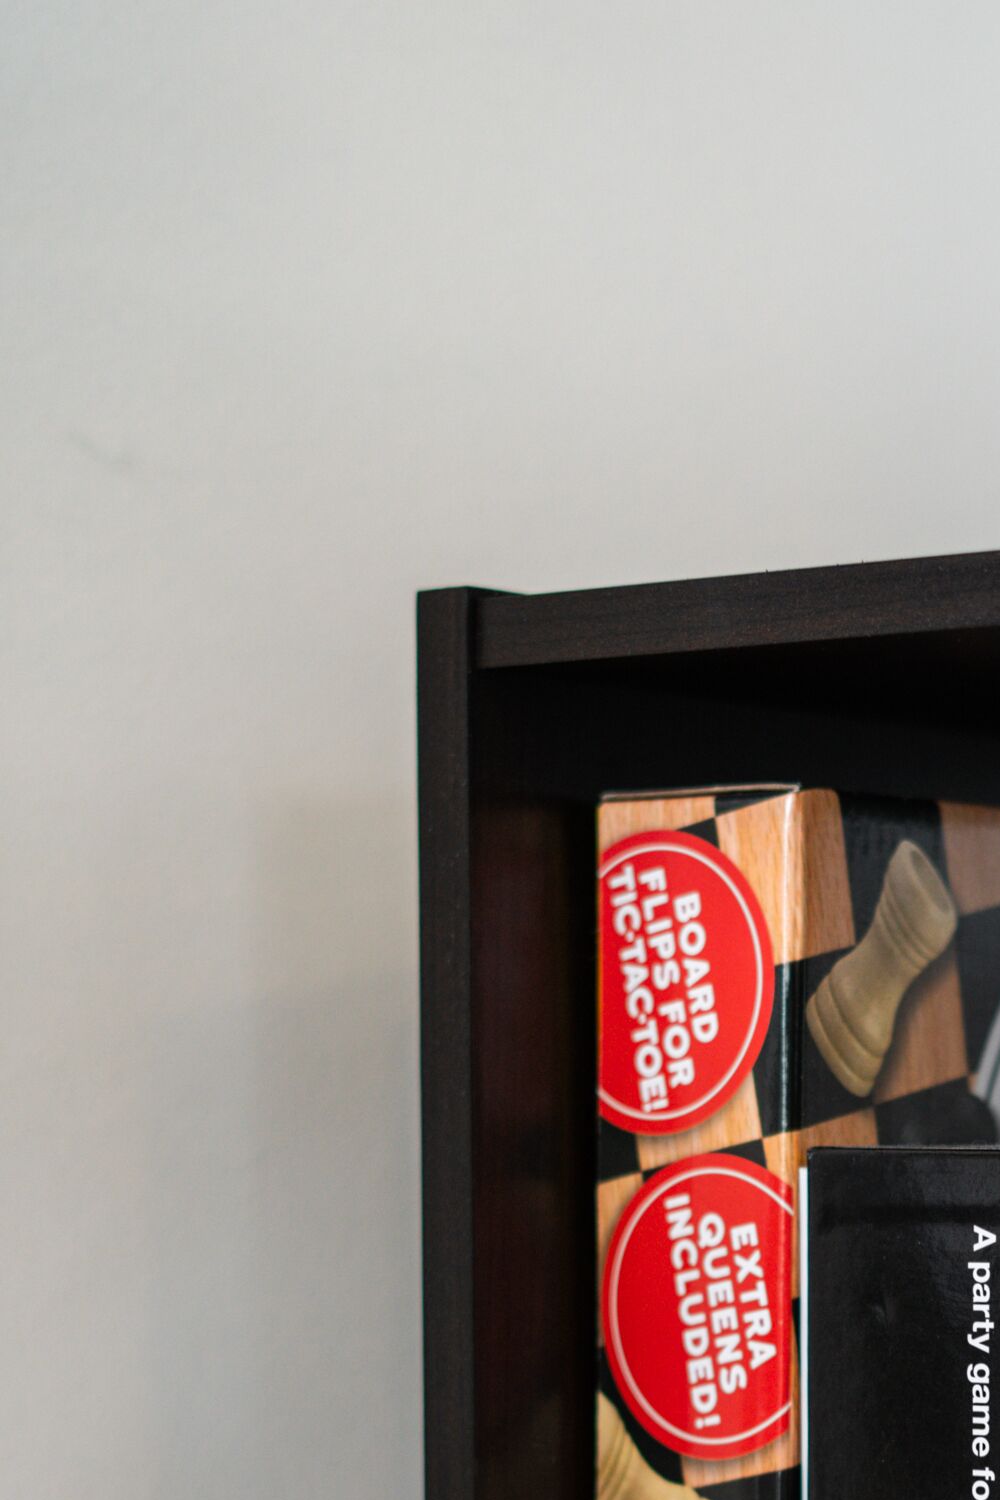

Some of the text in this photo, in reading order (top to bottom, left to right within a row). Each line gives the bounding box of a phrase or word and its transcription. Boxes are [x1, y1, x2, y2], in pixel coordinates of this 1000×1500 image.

[639, 867, 695, 1088] FLIPS FOR
[673, 891, 719, 1044] BOARD
[664, 1193, 721, 1429] INCLUDED!
[698, 1213, 748, 1395] QUEENS
[730, 1222, 777, 1370] EXTRA
[967, 1261, 994, 1353] party
[973, 1224, 997, 1251] A
[966, 1363, 991, 1458] game
